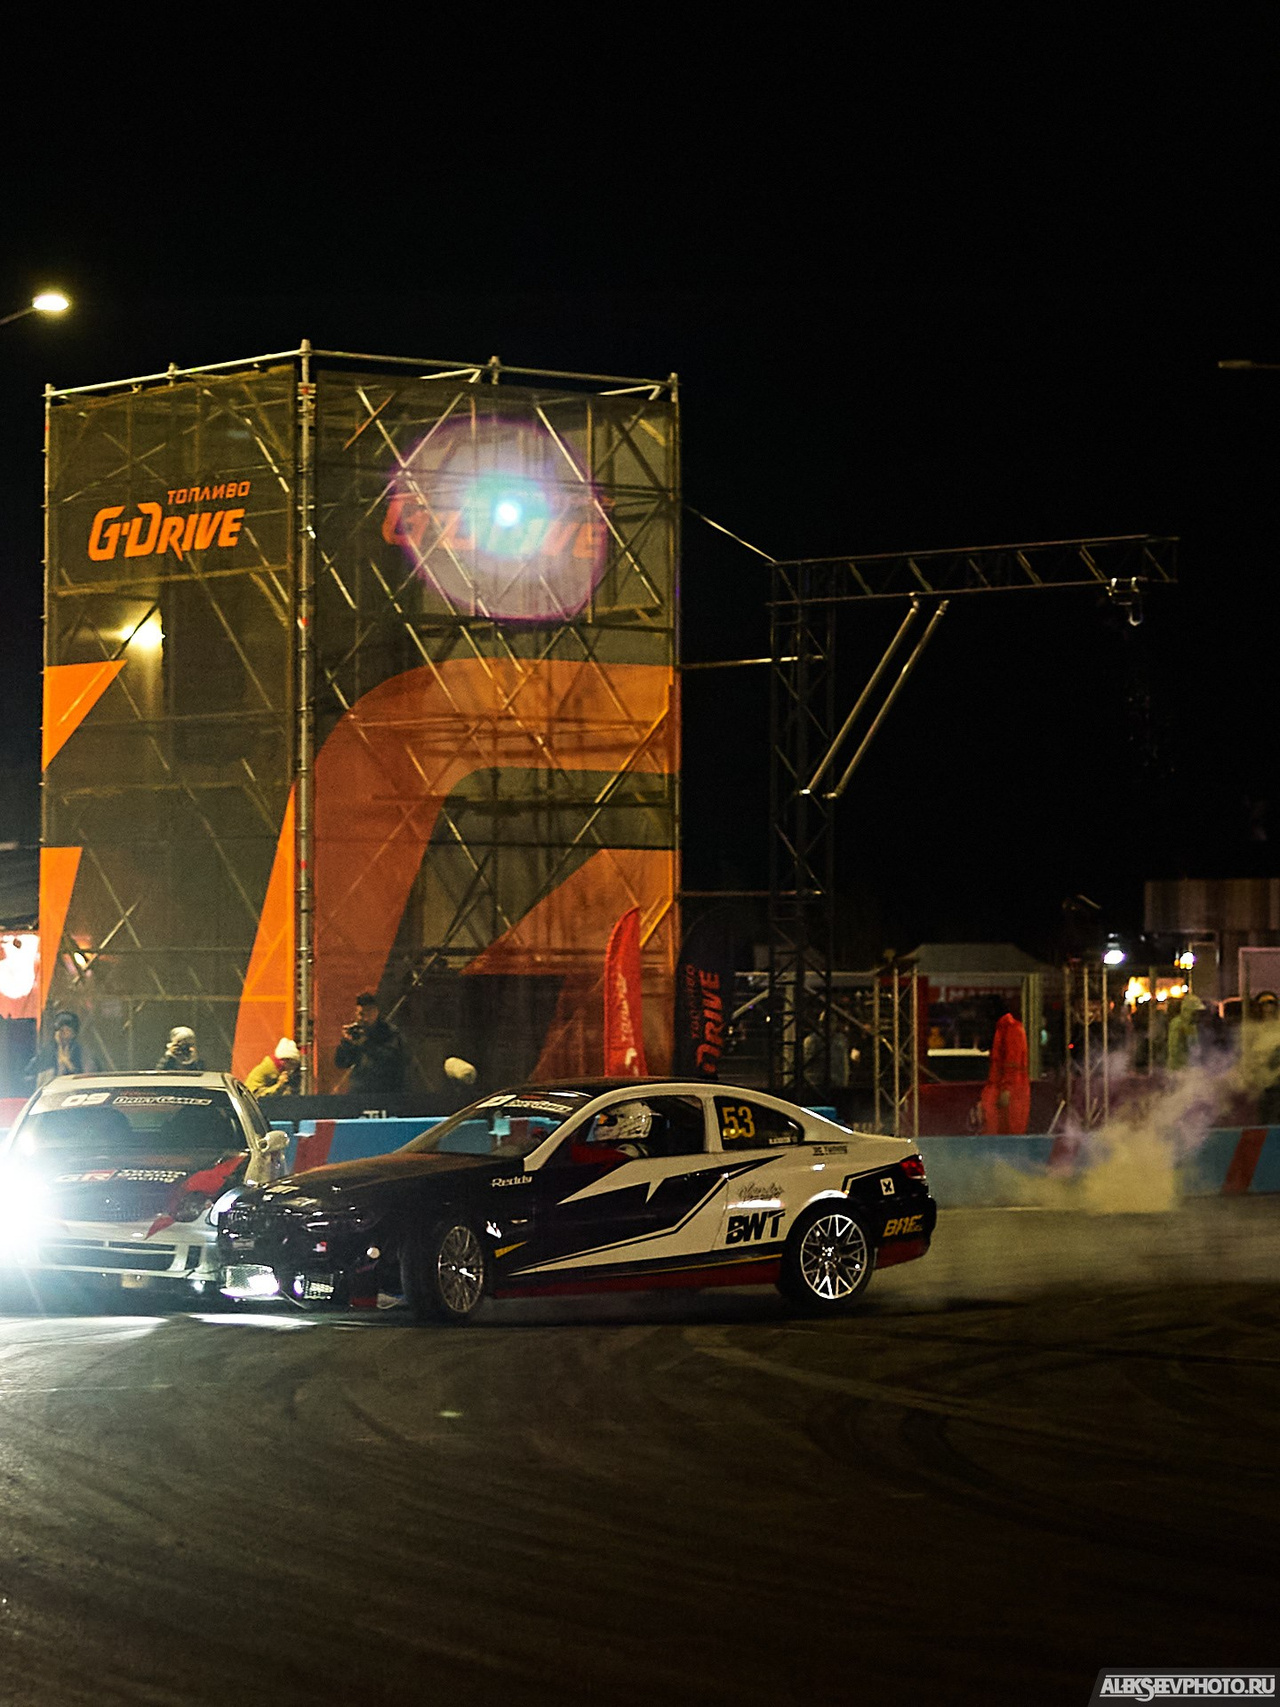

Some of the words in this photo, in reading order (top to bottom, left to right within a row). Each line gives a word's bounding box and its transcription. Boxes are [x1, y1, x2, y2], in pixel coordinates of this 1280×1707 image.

[167, 481, 251, 505] ТОПЛИВО
[722, 1105, 756, 1140] 53
[725, 1209, 786, 1245] BWT
